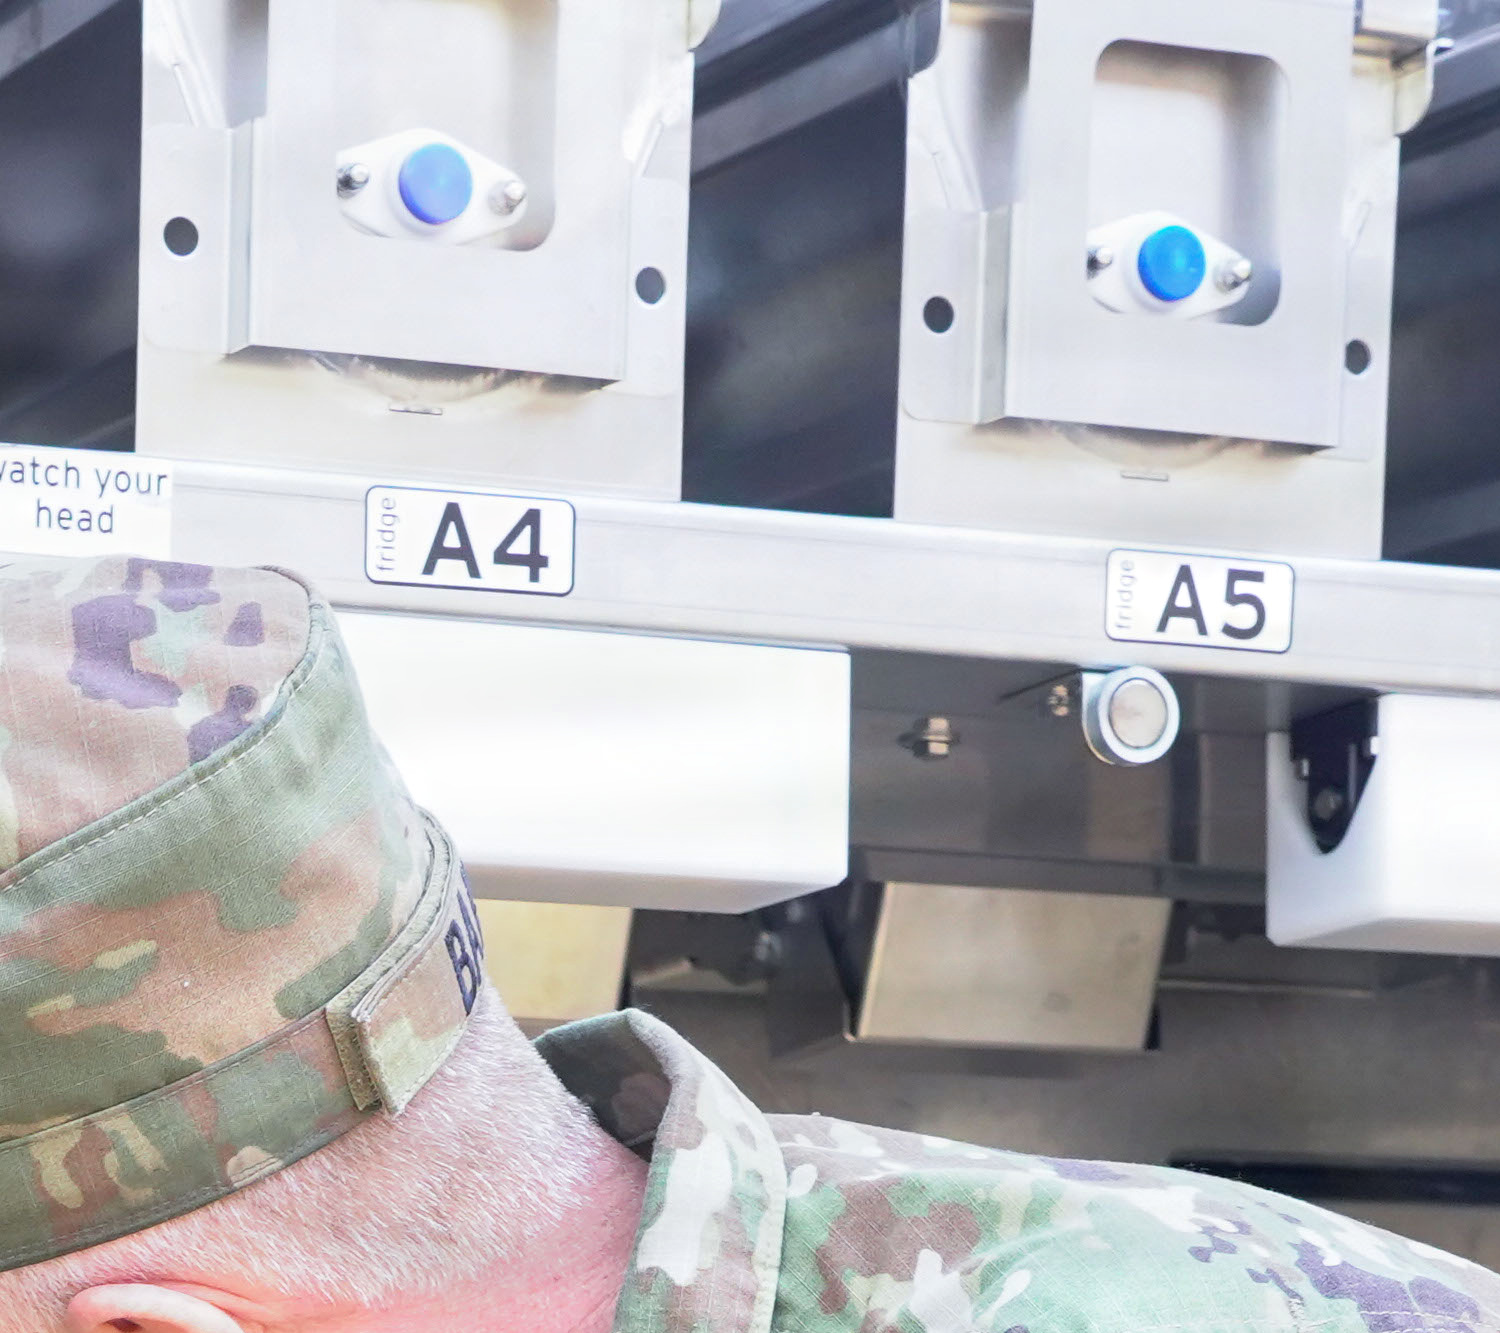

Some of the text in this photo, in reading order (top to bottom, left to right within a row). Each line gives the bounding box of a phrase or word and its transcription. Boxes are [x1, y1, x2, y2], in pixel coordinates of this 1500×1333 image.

[35, 497, 114, 534] head
[94, 467, 168, 499] your
[375, 496, 400, 573] fridge
[421, 500, 550, 584] A4
[1115, 558, 1137, 630] fridge
[1155, 564, 1267, 640] A5
